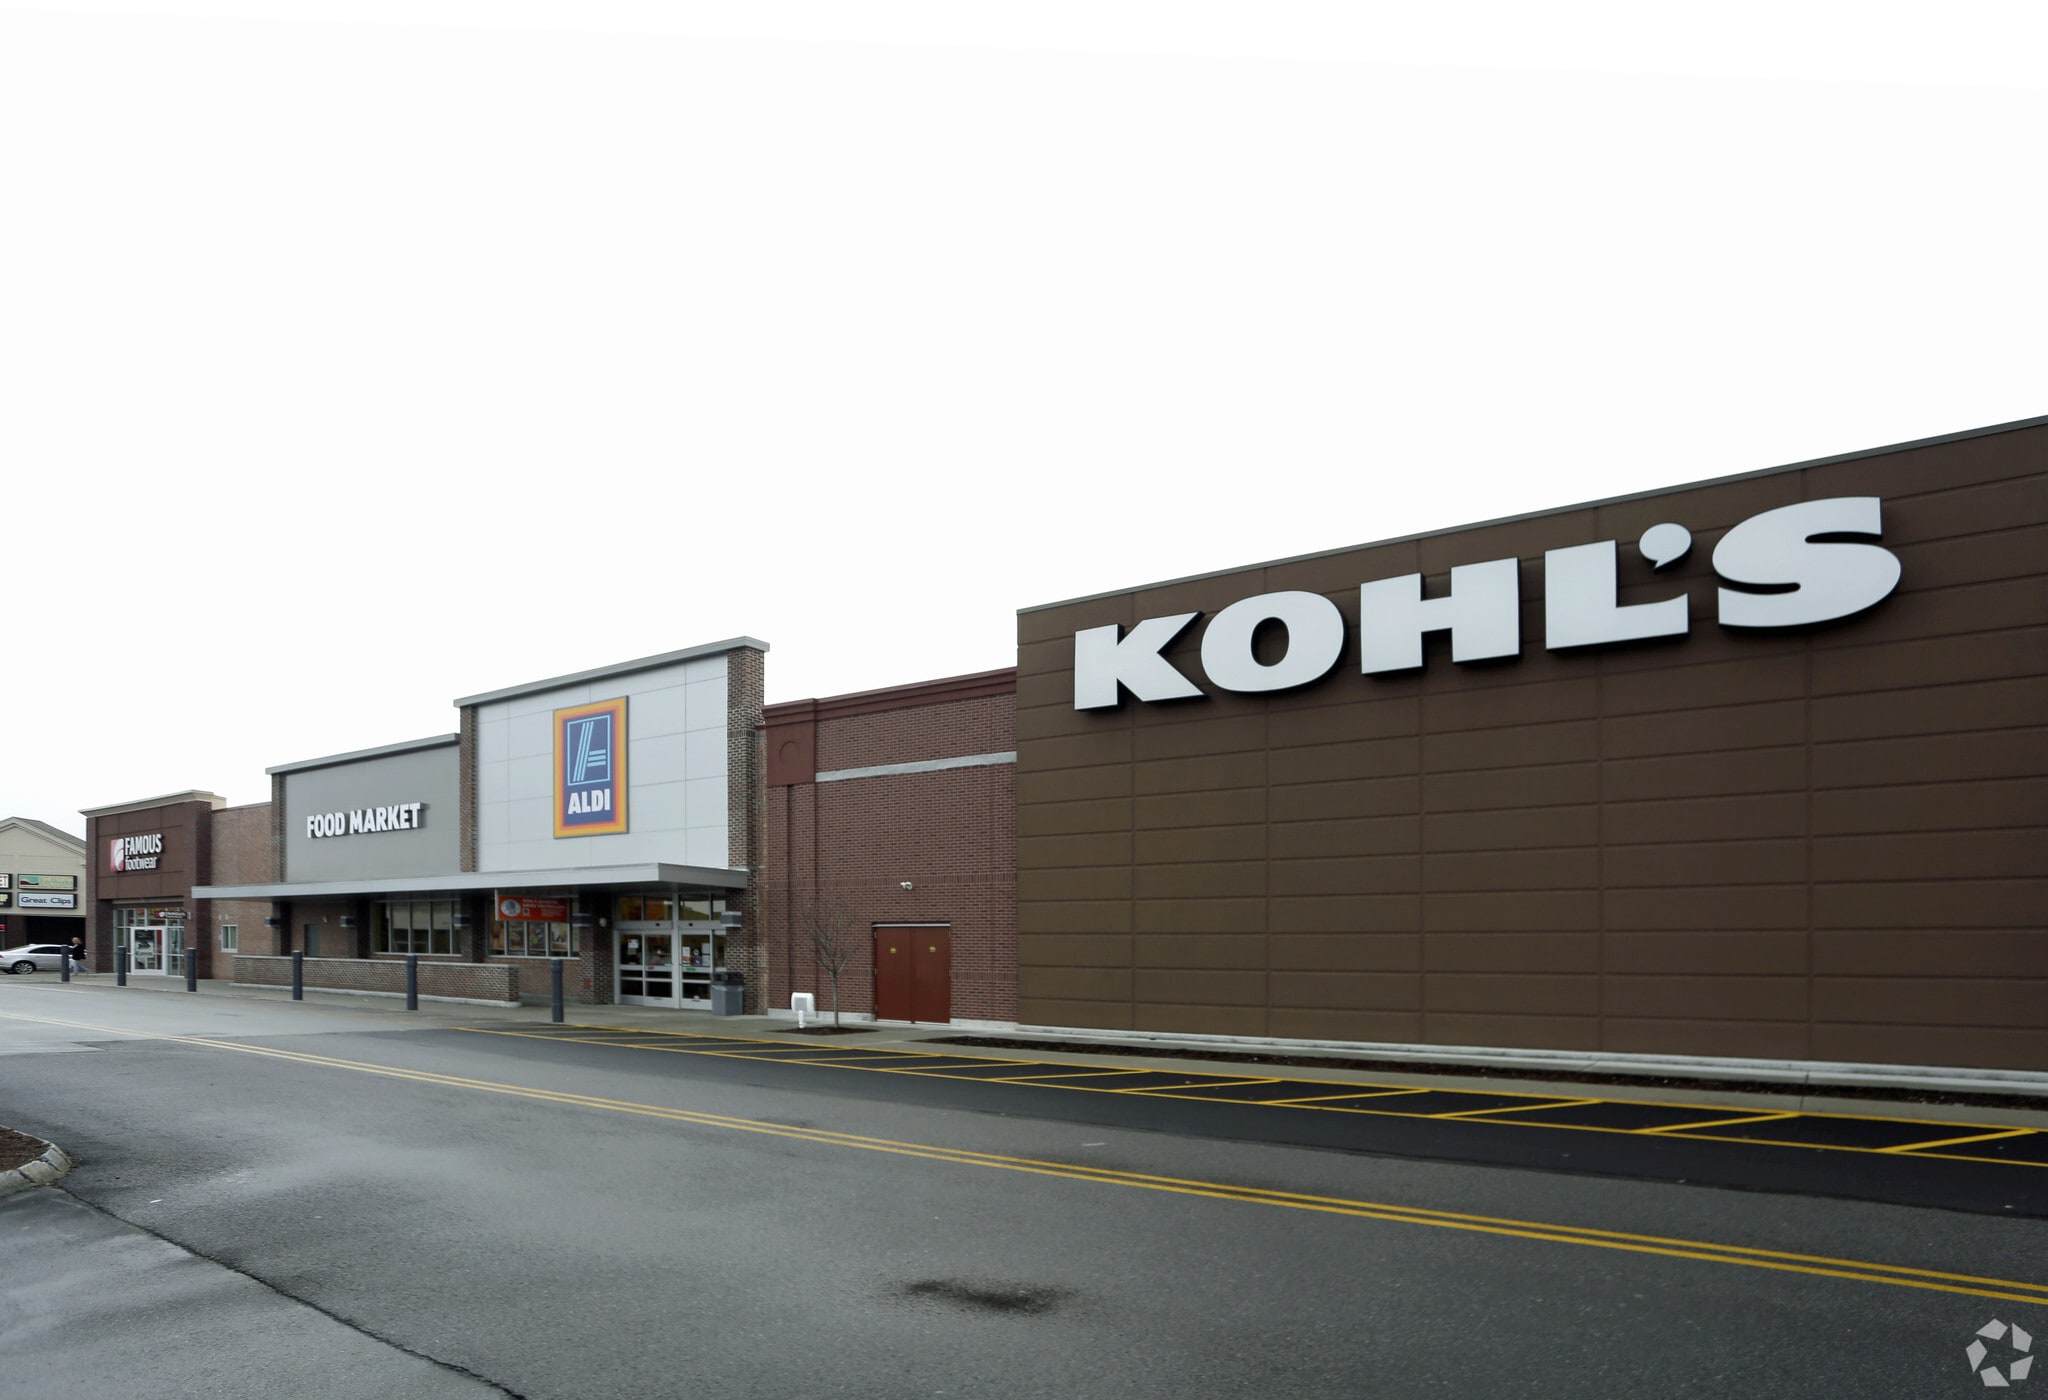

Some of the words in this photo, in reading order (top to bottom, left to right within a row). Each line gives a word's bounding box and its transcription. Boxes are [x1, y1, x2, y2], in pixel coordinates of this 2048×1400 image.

[1074, 496, 1902, 711] KOHL'S
[567, 788, 611, 815] ALDI
[306, 811, 346, 838] FOOD
[349, 802, 421, 834] MARKET
[125, 834, 162, 856] FAMOUS
[125, 856, 158, 870] footwear
[21, 896, 47, 904] Great
[50, 897, 72, 905] Clips
